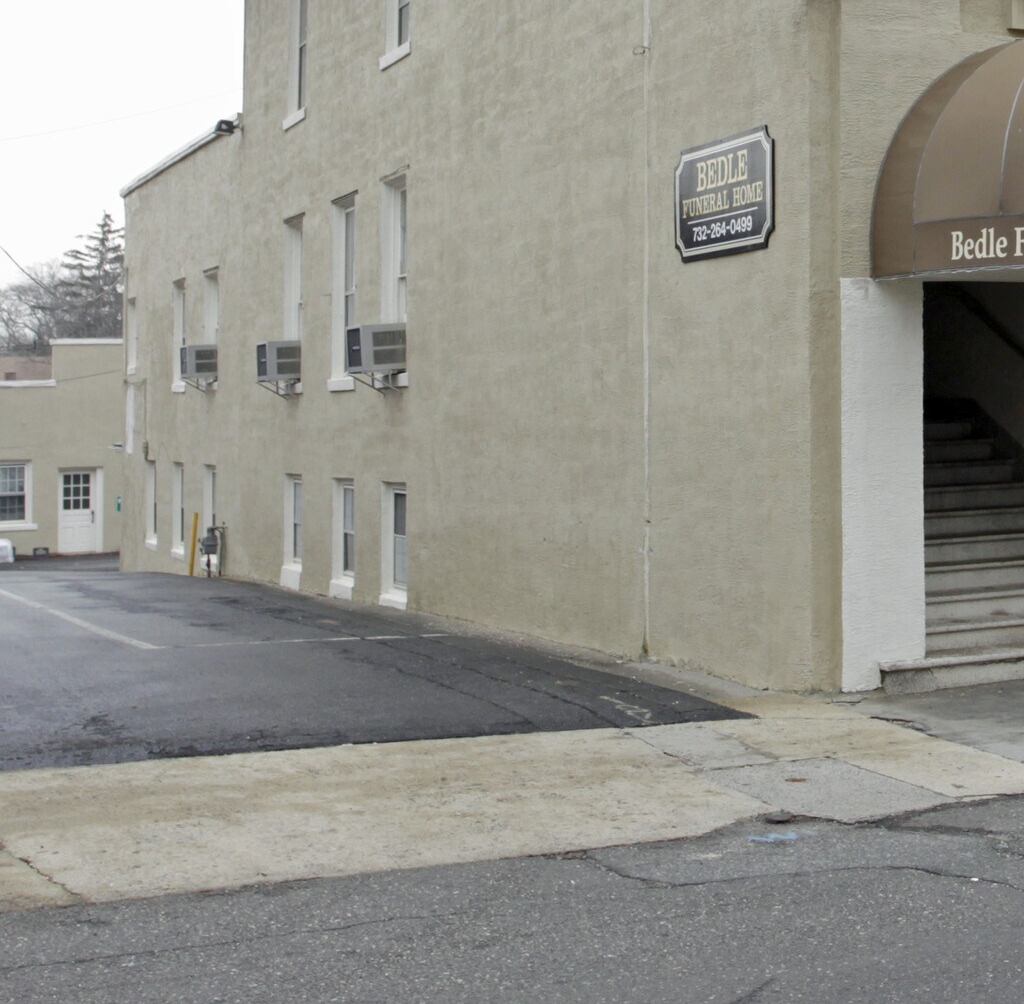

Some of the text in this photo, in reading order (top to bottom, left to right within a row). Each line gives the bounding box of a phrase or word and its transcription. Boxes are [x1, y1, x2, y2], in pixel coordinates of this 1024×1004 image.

[696, 149, 748, 192] BEDLE
[682, 181, 764, 219] FUNERAL HOME
[692, 215, 753, 242] 732-264-0499
[951, 228, 1008, 261] Bedle
